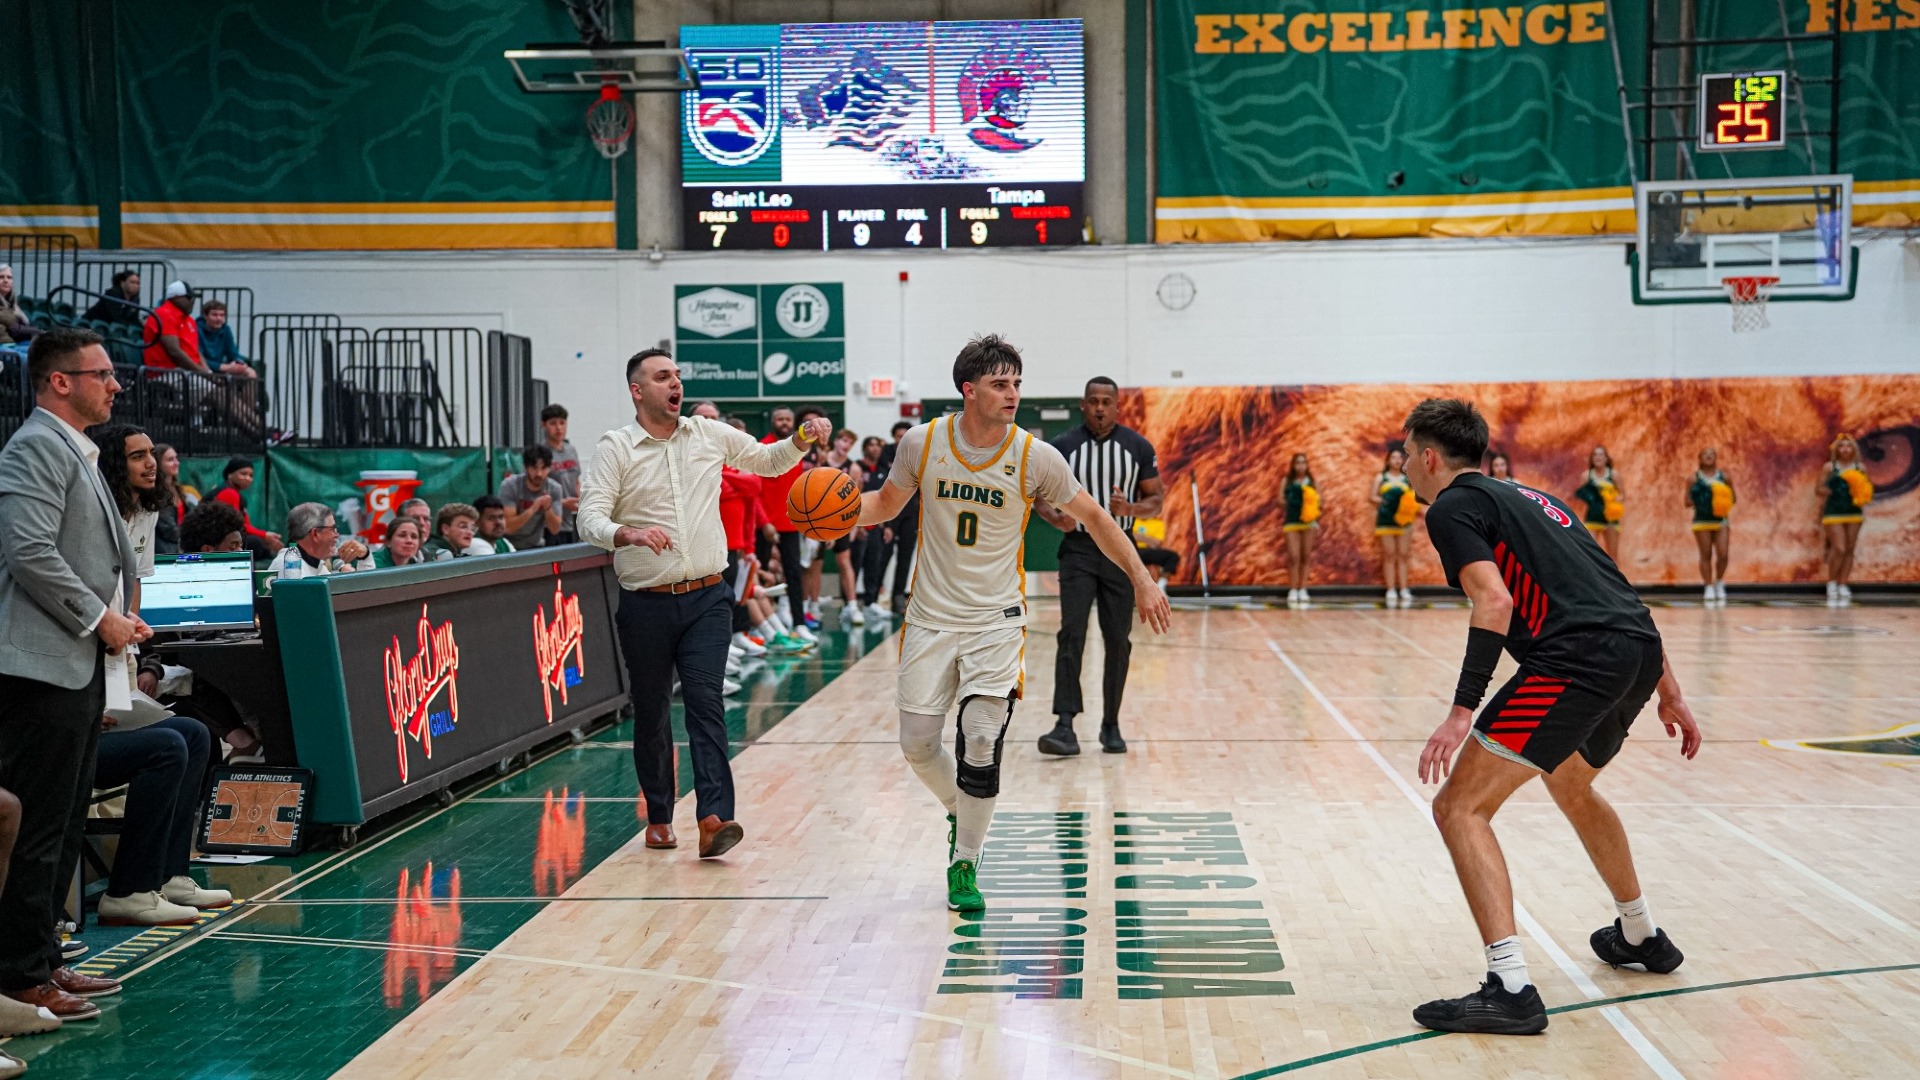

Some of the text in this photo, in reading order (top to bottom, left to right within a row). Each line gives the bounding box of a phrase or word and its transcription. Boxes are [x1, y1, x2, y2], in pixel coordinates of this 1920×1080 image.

[1195, 2, 1606, 54] EXCELLENCE
[1717, 102, 1769, 143] 25
[711, 190, 793, 208] Saint Leo
[987, 187, 1046, 207] Tampa
[837, 209, 886, 221] PLAYER
[896, 208, 929, 221] FOUL
[959, 207, 1000, 220] FOULS
[710, 224, 727, 247] 7
[773, 223, 790, 247] 0
[853, 223, 870, 246] 9
[905, 222, 923, 245] 4
[971, 221, 988, 244] 9
[1034, 220, 1047, 244] 1
[796, 358, 844, 378] pepsi
[370, 488, 390, 511] G
[937, 479, 1005, 509] LIONS
[1517, 487, 1572, 528] 3
[956, 510, 979, 547] 0
[429, 709, 455, 737] GRILL
[254, 774, 293, 782] ATHLETICS
[210, 786, 218, 804] LEO
[292, 823, 300, 840] LEO
[937, 812, 1091, 999] BISCARDI COURT
[1113, 812, 1295, 999] PETE & LINDA
